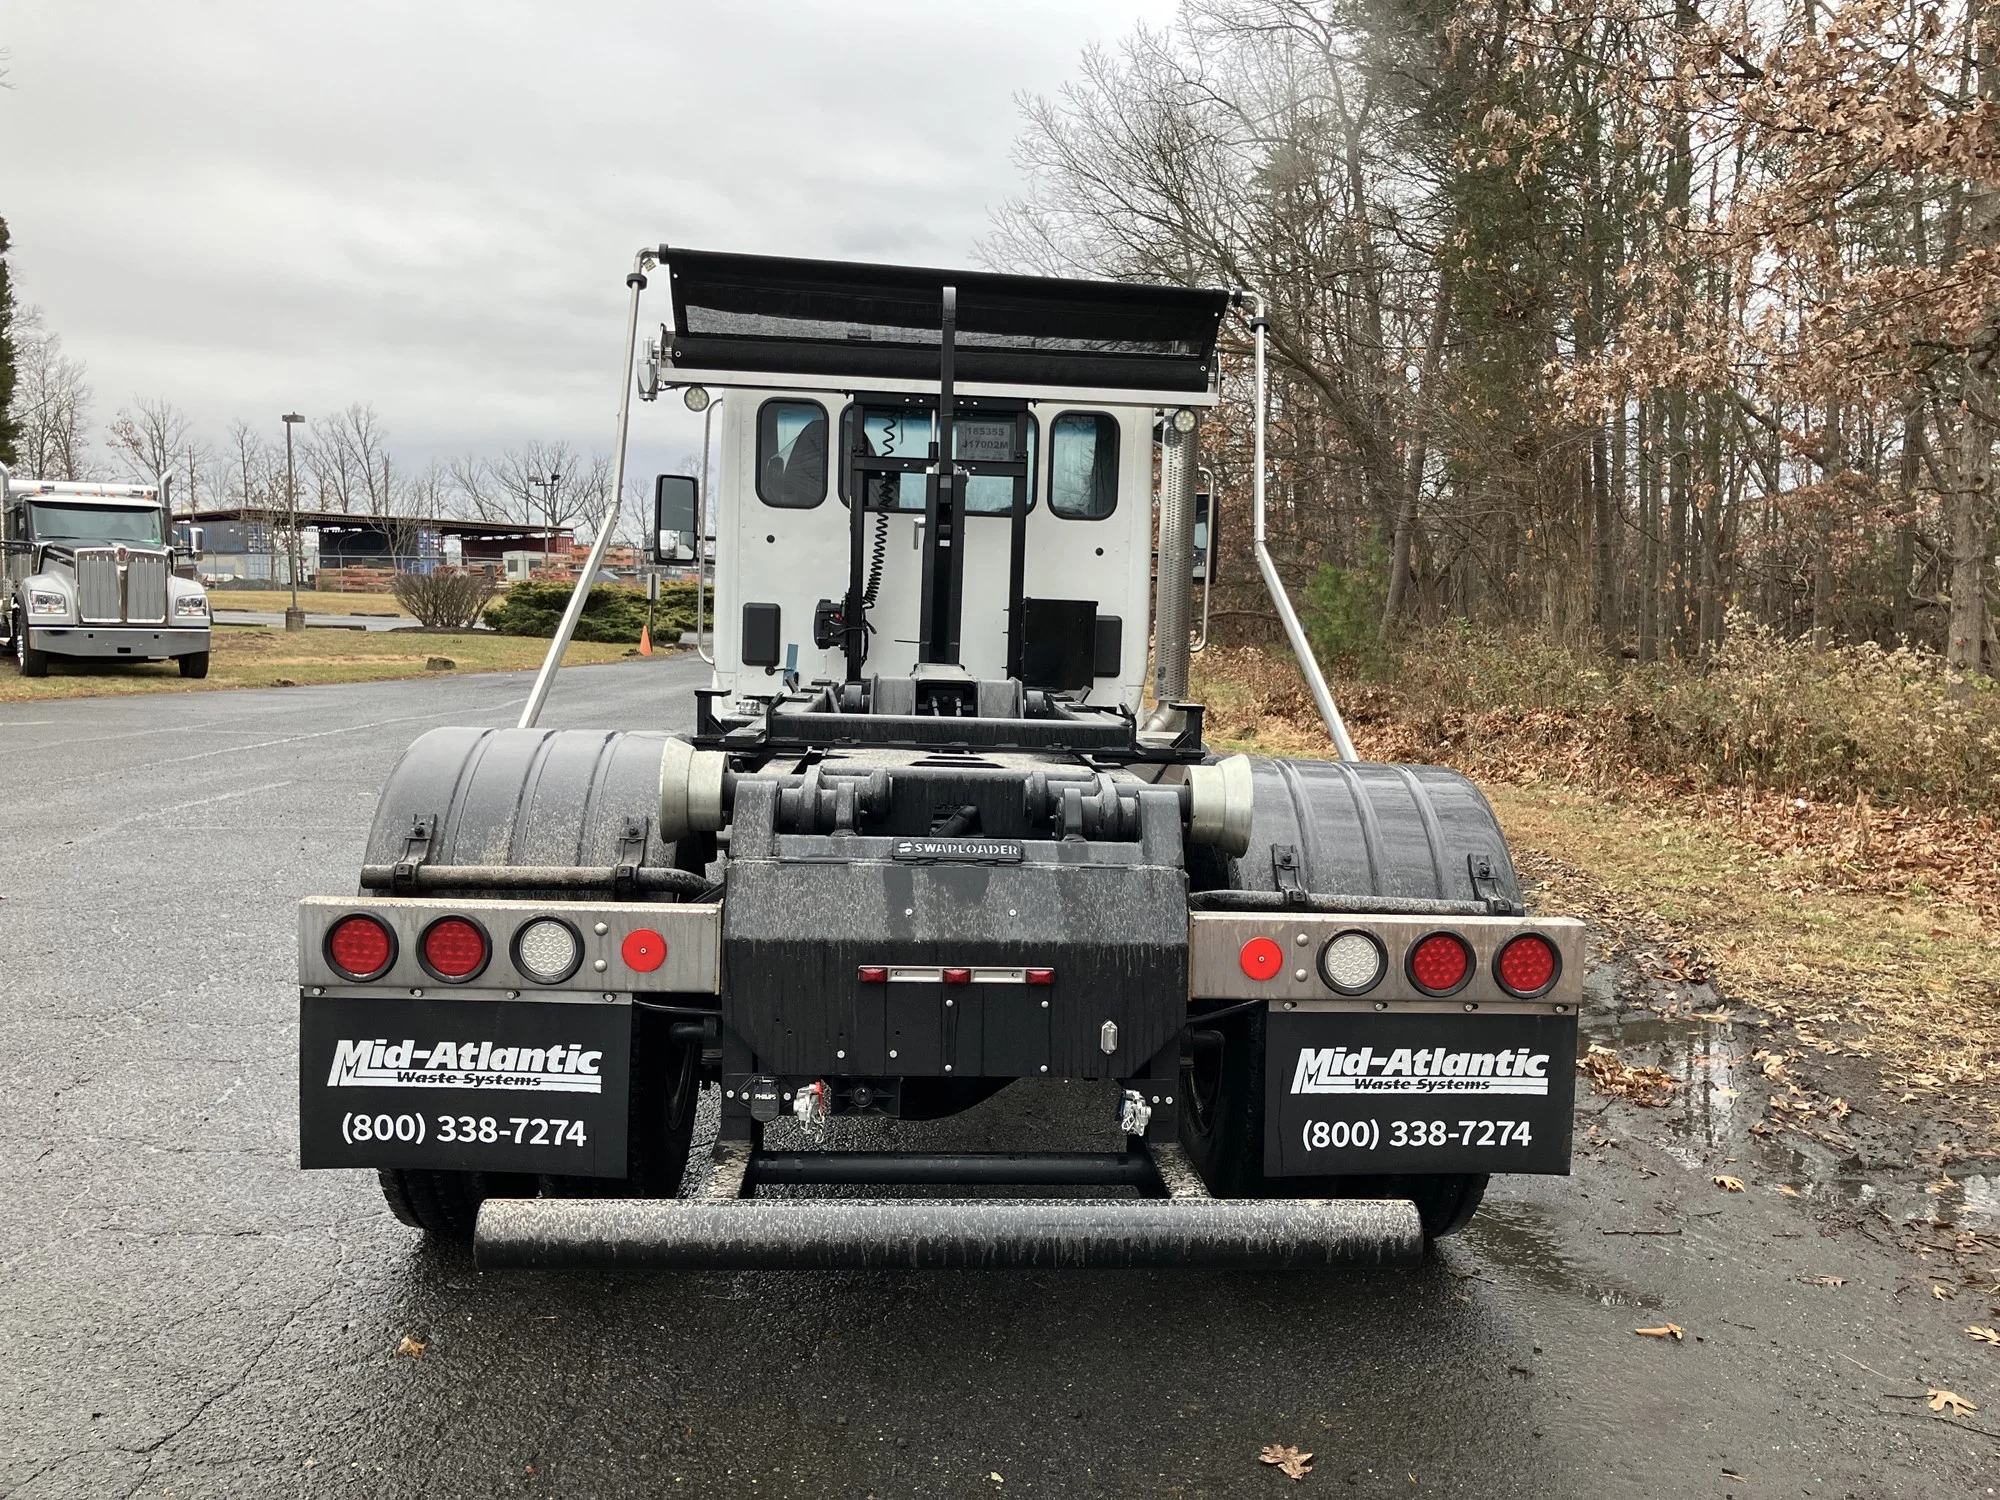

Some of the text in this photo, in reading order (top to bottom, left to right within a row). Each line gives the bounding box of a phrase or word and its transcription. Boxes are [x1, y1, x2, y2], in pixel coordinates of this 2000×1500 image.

[915, 843, 1018, 855] SWAPLOADER
[327, 1038, 603, 1087] Mid-Atlantic
[396, 1070, 542, 1088] Waste Systems
[1290, 1047, 1550, 1095] Mid-Atlantic
[1354, 1078, 1491, 1093] Waste Systems
[342, 1112, 587, 1147] (800) 338-7274
[1302, 1118, 1533, 1152] (800) 338-7274
